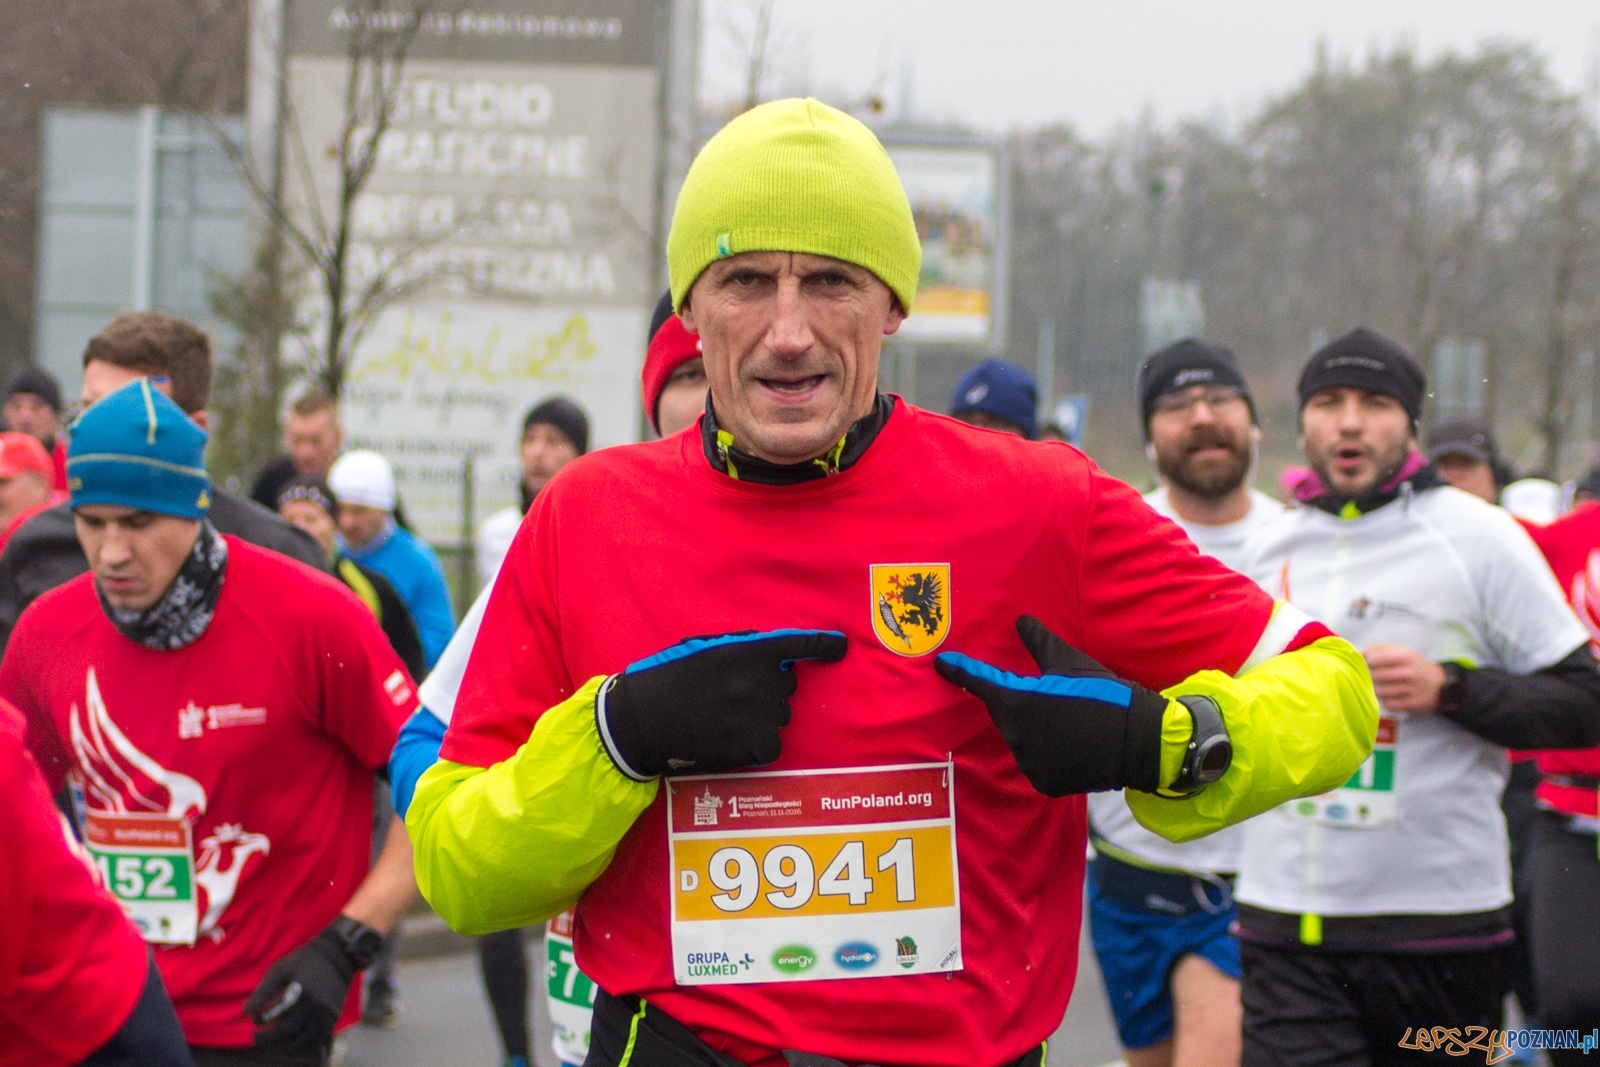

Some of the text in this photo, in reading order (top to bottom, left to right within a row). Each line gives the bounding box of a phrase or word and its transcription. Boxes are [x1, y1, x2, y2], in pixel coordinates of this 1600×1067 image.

[728, 796, 741, 818] 1
[821, 792, 932, 810] RunPoland.org
[680, 836, 917, 913] D 9941
[687, 952, 730, 964] GRUPA
[778, 955, 813, 968] energy
[687, 964, 739, 977] LUXMED
